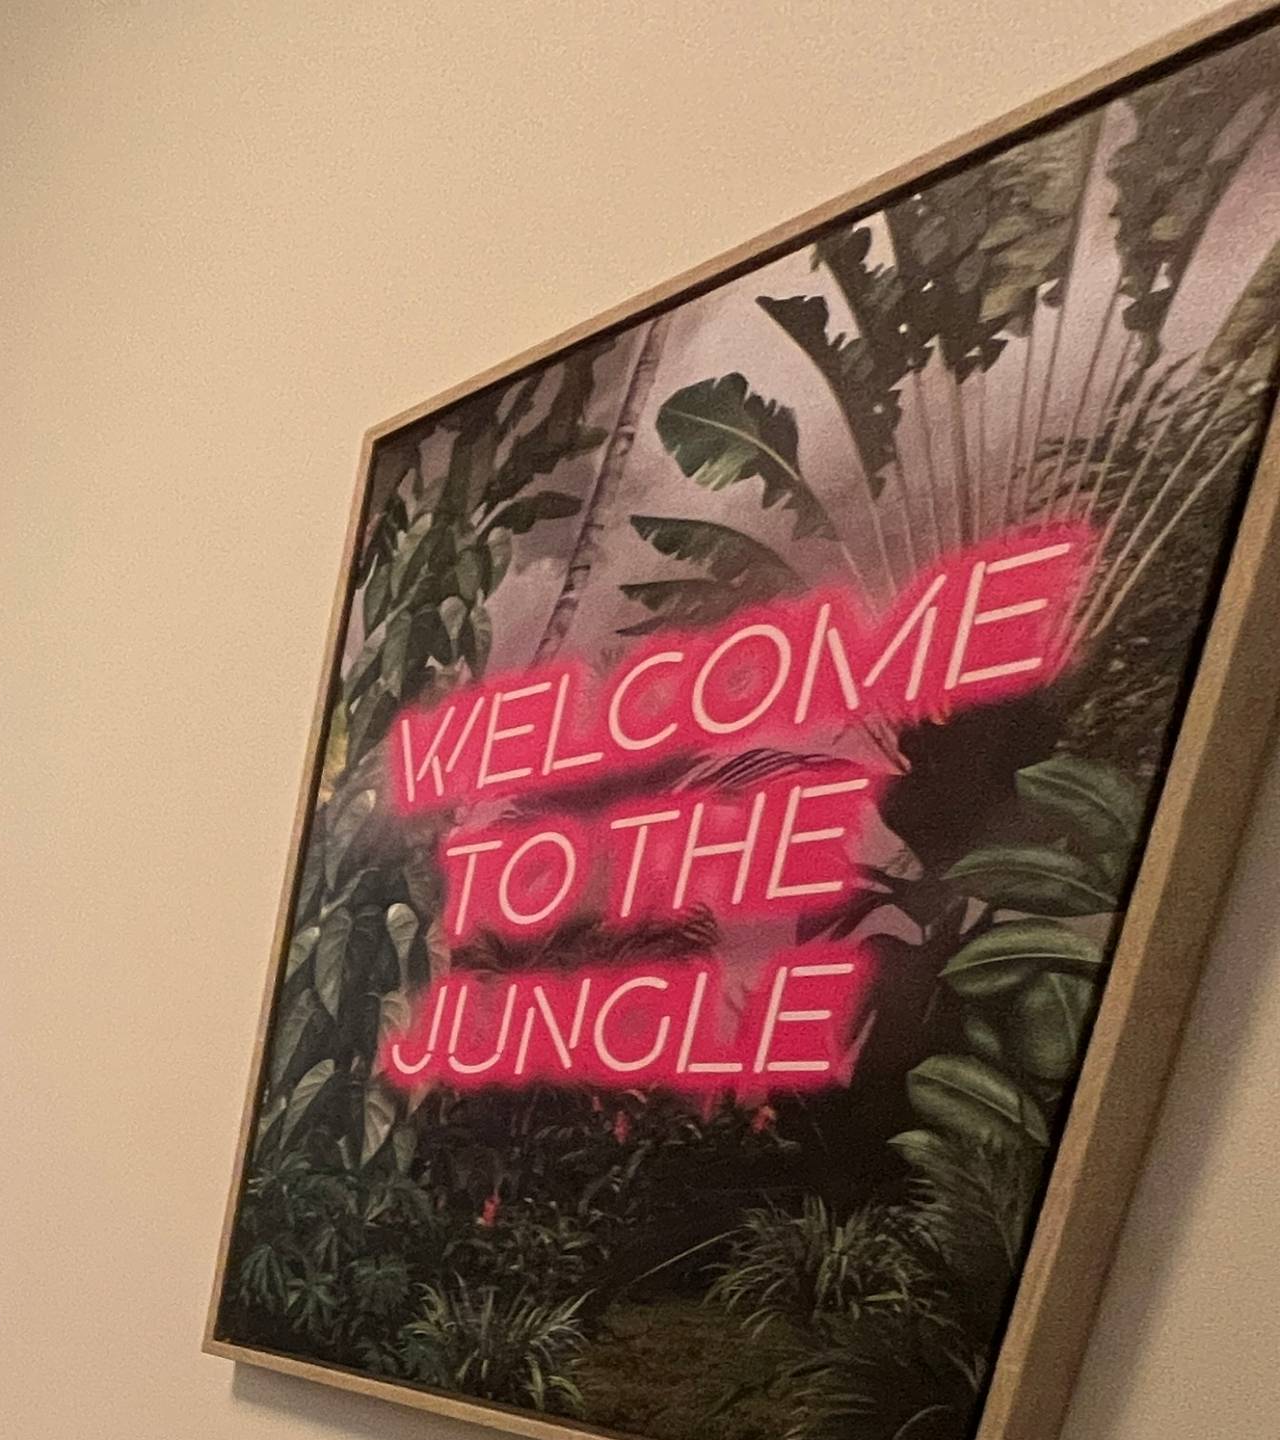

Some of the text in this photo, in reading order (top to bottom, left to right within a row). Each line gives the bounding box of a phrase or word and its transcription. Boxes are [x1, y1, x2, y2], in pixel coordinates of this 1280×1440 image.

[399, 543, 1071, 802] WELCOME
[446, 779, 870, 936] TO THE
[392, 963, 855, 1075] JUNGLE
